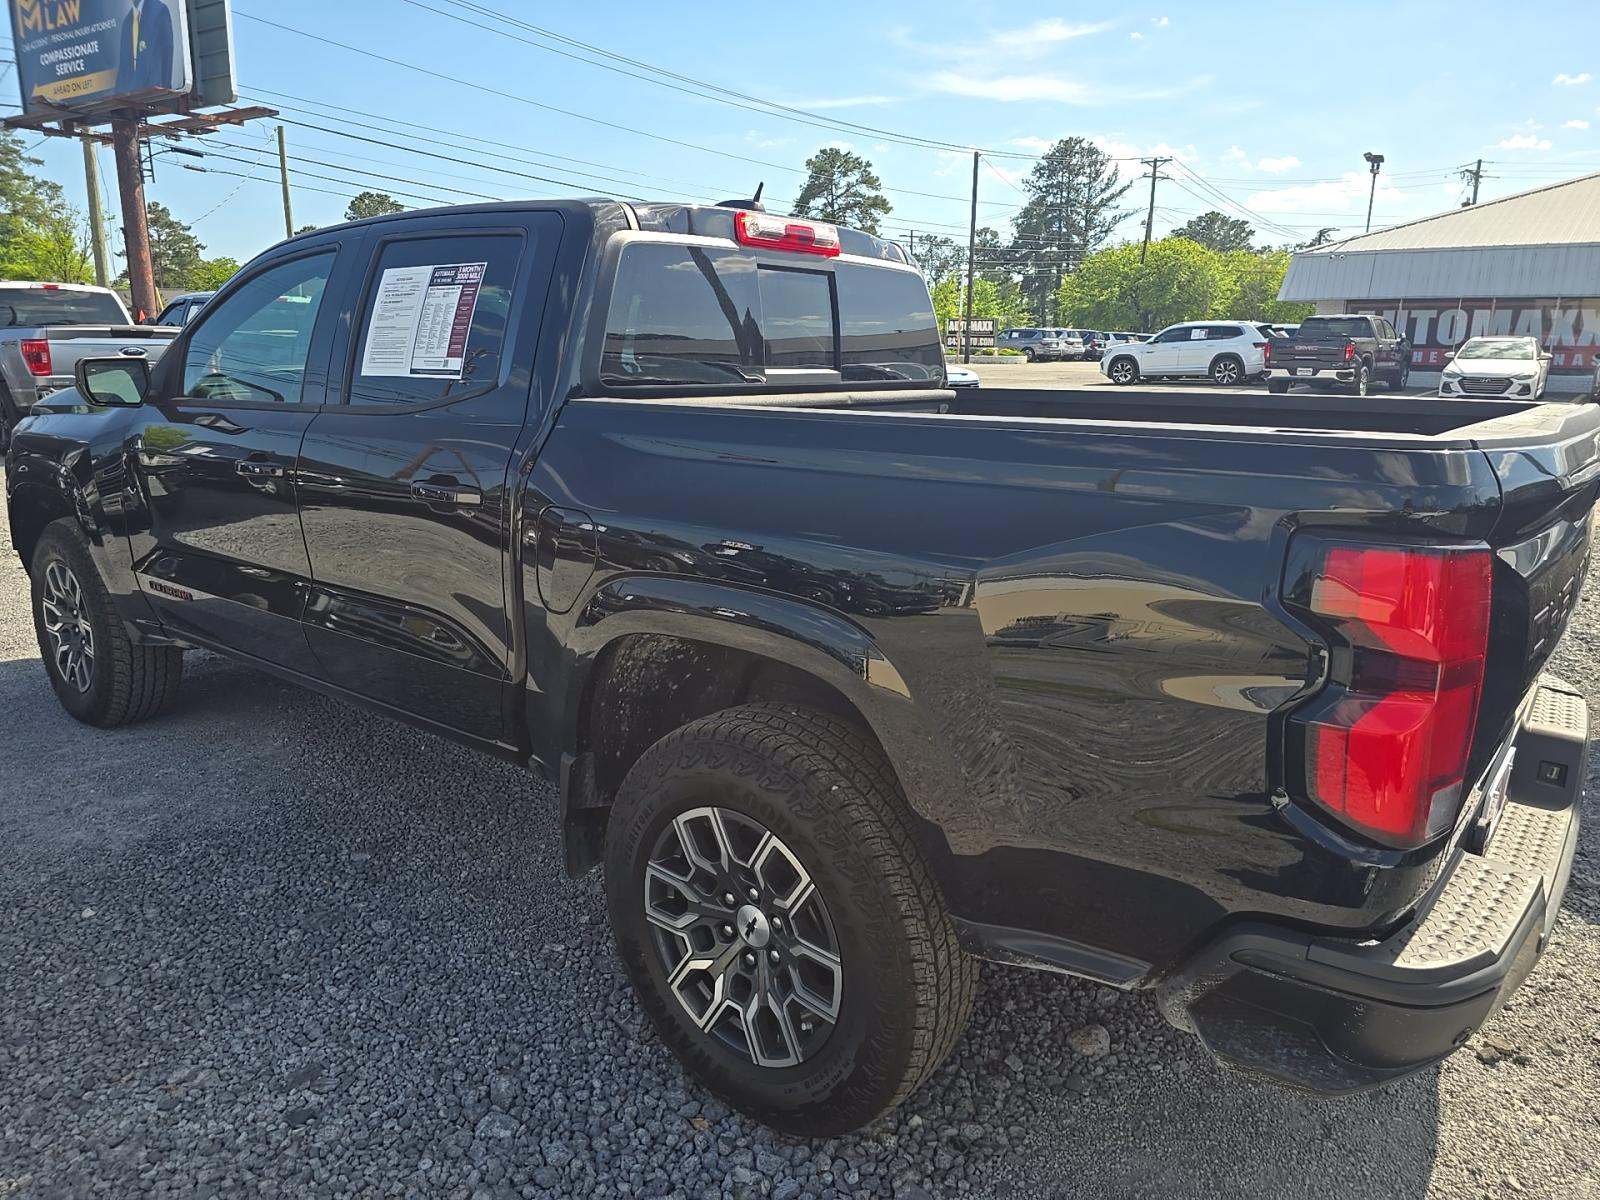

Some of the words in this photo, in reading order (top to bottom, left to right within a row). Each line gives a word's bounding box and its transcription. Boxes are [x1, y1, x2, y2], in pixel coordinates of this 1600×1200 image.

[45, 0, 80, 30] LAW
[40, 41, 99, 65] COMPASSIONATE
[55, 59, 86, 77] SERVICE
[53, 84, 70, 94] AHEAD
[71, 81, 82, 92] ON
[82, 80, 92, 90] LEFT
[462, 265, 482, 273] MONTH
[1357, 309, 1600, 346] UTOMAXX
[1412, 352, 1438, 362] HE
